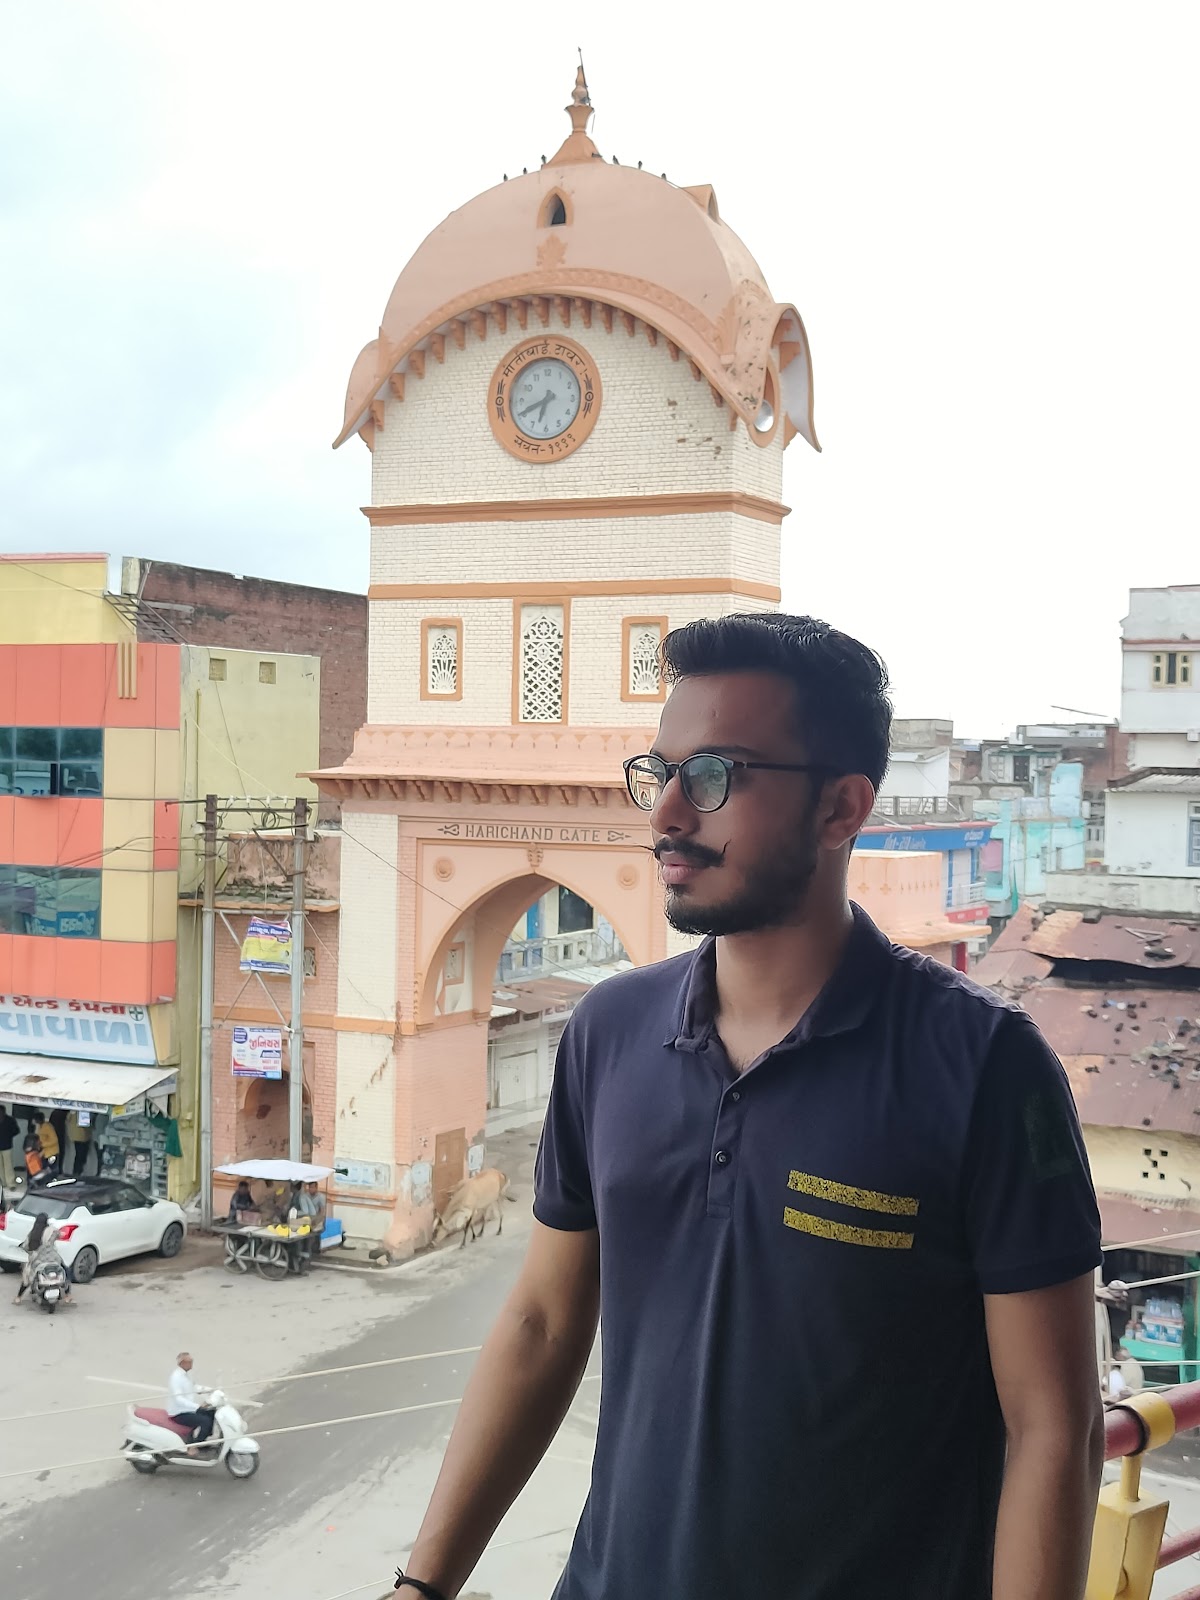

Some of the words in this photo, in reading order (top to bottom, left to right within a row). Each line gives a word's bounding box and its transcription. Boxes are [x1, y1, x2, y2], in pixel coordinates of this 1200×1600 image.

[544, 368, 552, 377] 12
[558, 371, 563, 380] 1
[533, 373, 540, 382] 11
[524, 384, 533, 393] 10
[567, 381, 572, 390] 2
[570, 394, 576, 403] 3
[565, 408, 571, 416] 4
[530, 420, 536, 429] 7
[556, 419, 562, 428] 5
[543, 424, 549, 433] 6
[465, 824, 554, 841] HARICHAND
[559, 828, 601, 842] GATE
